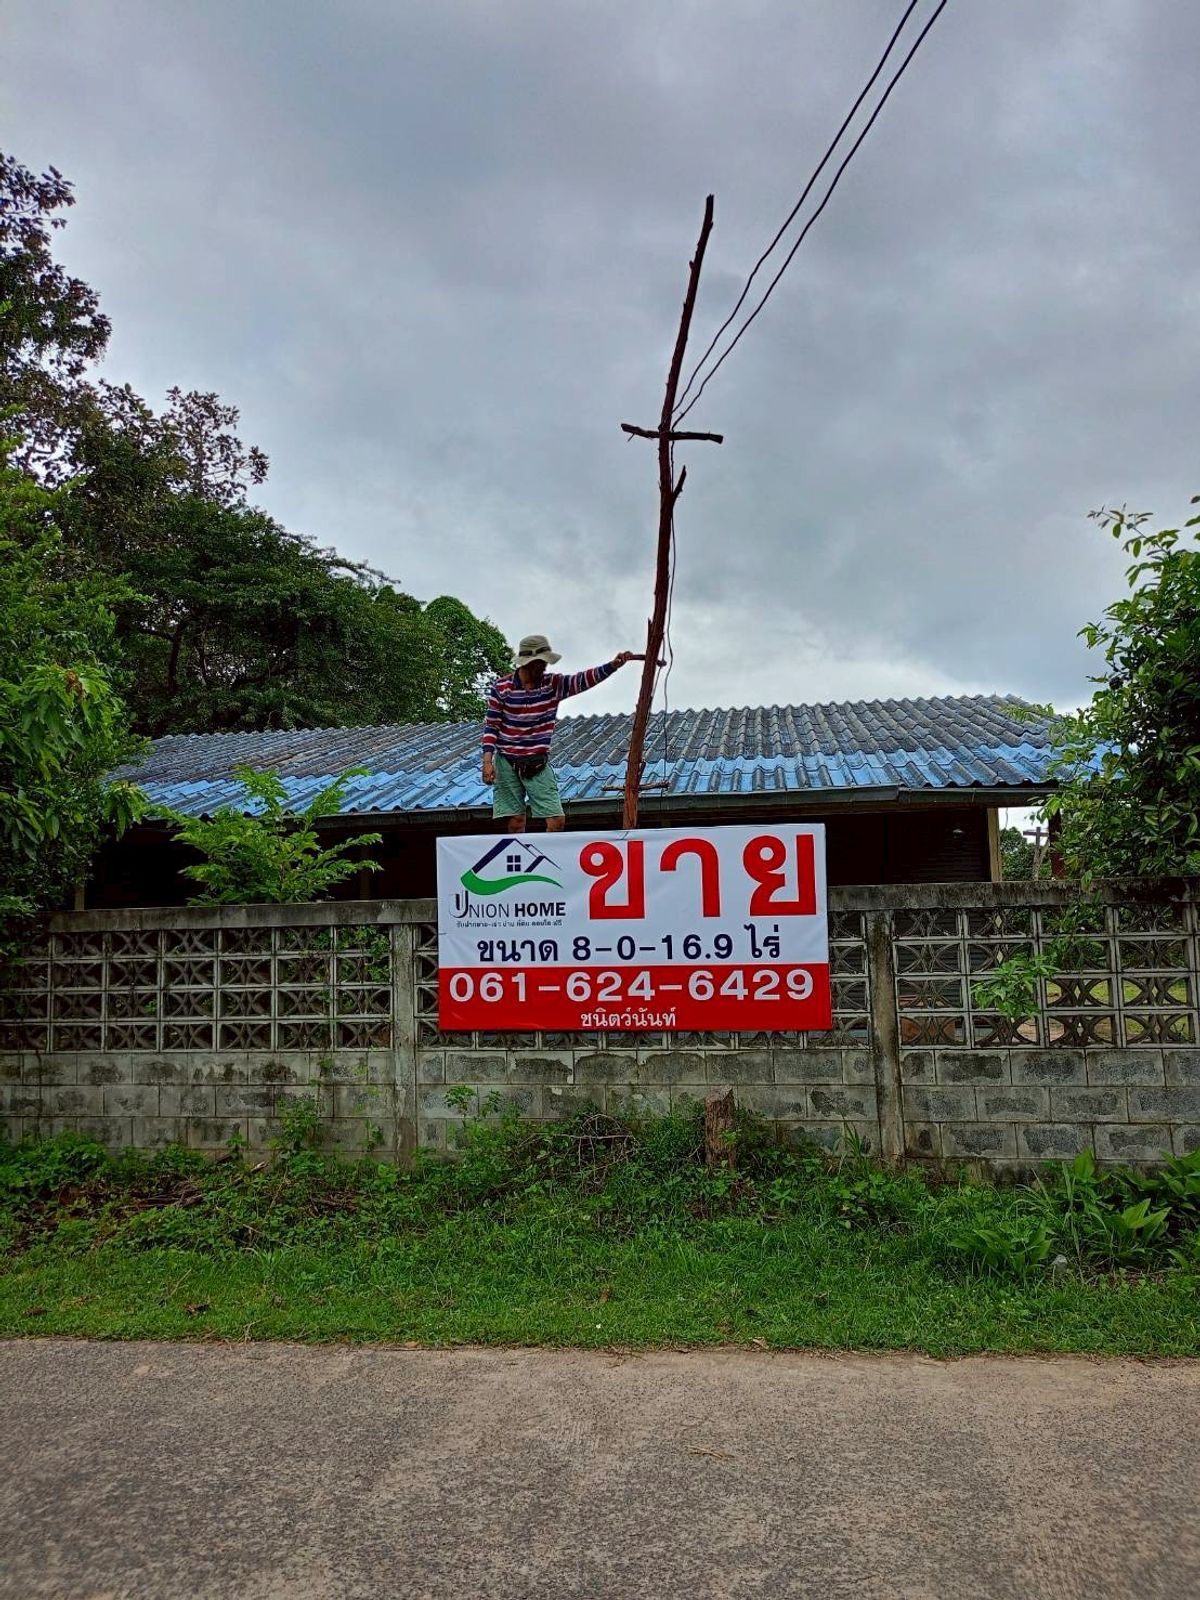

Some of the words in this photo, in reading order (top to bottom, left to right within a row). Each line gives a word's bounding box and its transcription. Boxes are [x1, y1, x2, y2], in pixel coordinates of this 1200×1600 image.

[579, 833, 817, 920] ขาย
[449, 890, 510, 919] UNION
[514, 902, 566, 918] HOME
[477, 938, 559, 963] ขนาด
[572, 933, 734, 961] 8-0-16.9
[743, 923, 781, 959] ไร่
[448, 968, 815, 1003] 061-624-6429
[580, 1007, 677, 1027] ชนิตว์นันท์
